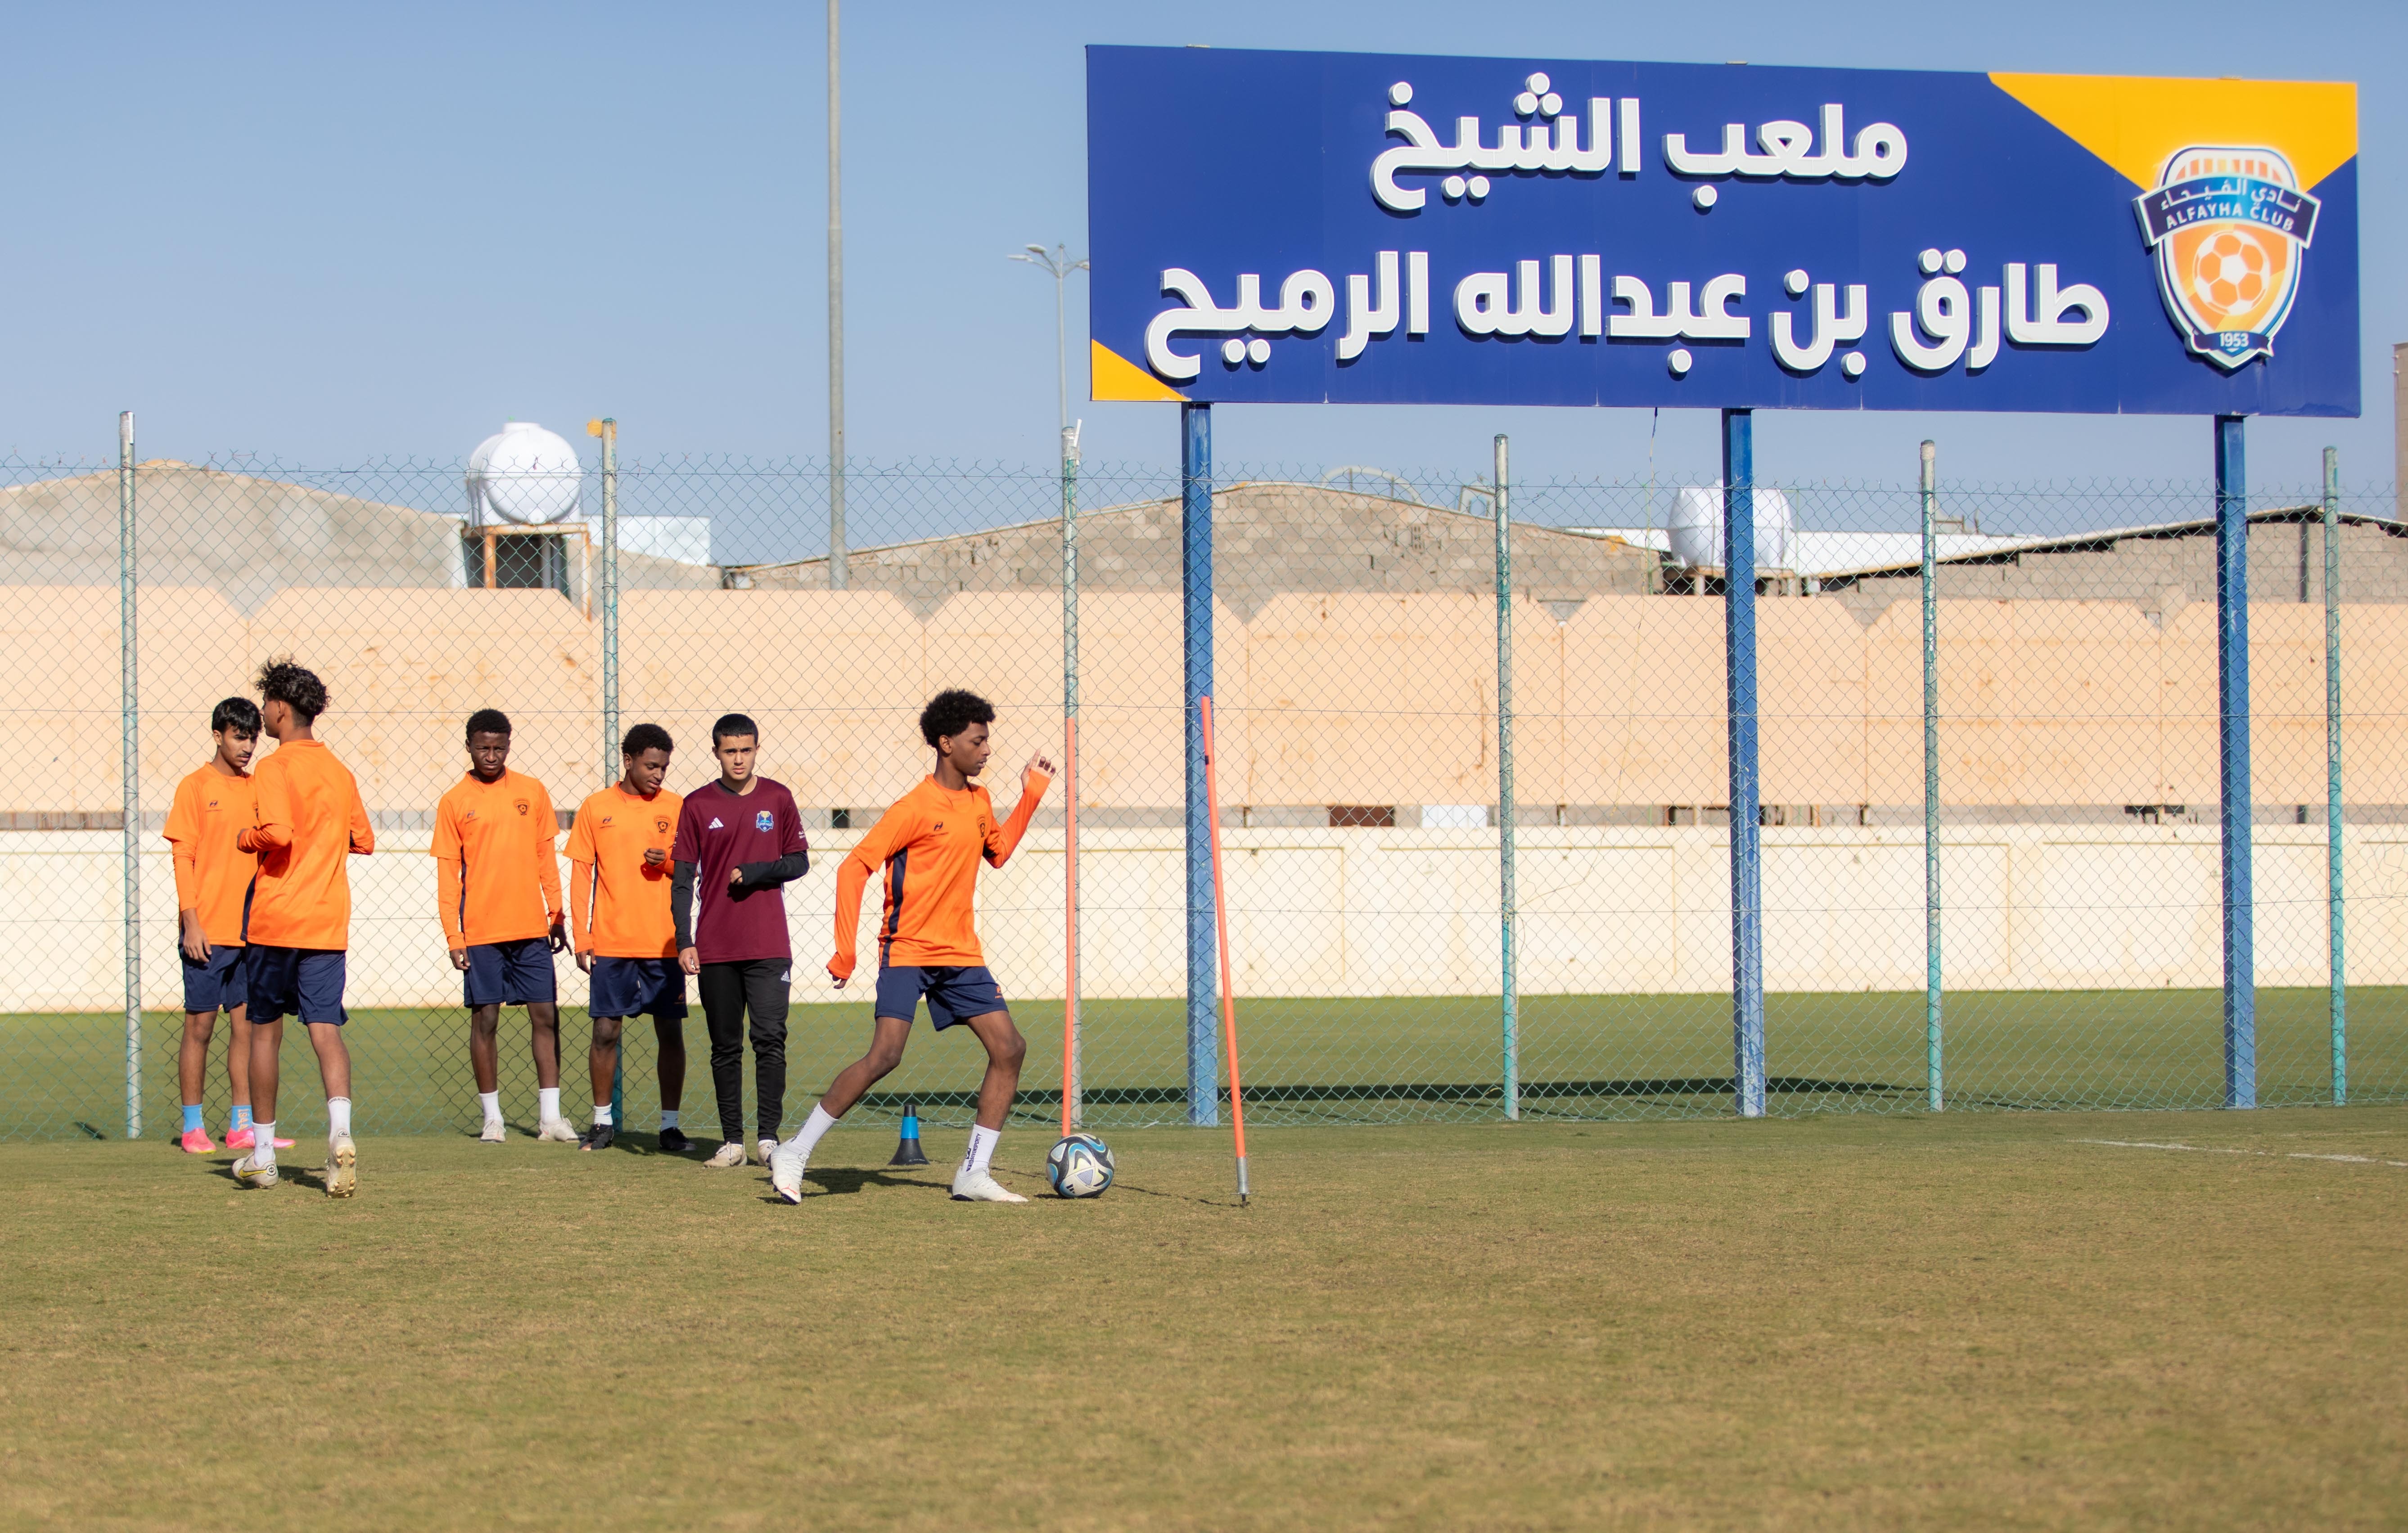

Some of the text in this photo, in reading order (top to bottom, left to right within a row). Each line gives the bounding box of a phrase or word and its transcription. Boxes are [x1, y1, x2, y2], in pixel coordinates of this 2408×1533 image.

[1370, 72, 1908, 212] ملعب الشيخ
[2160, 177, 2302, 213] نادي الفيحاء
[2166, 202, 2294, 231] ALFAYHA CLUB
[1144, 248, 2111, 380] طارق بن عبدالله الرميح
[2219, 333, 2250, 347] 1953
